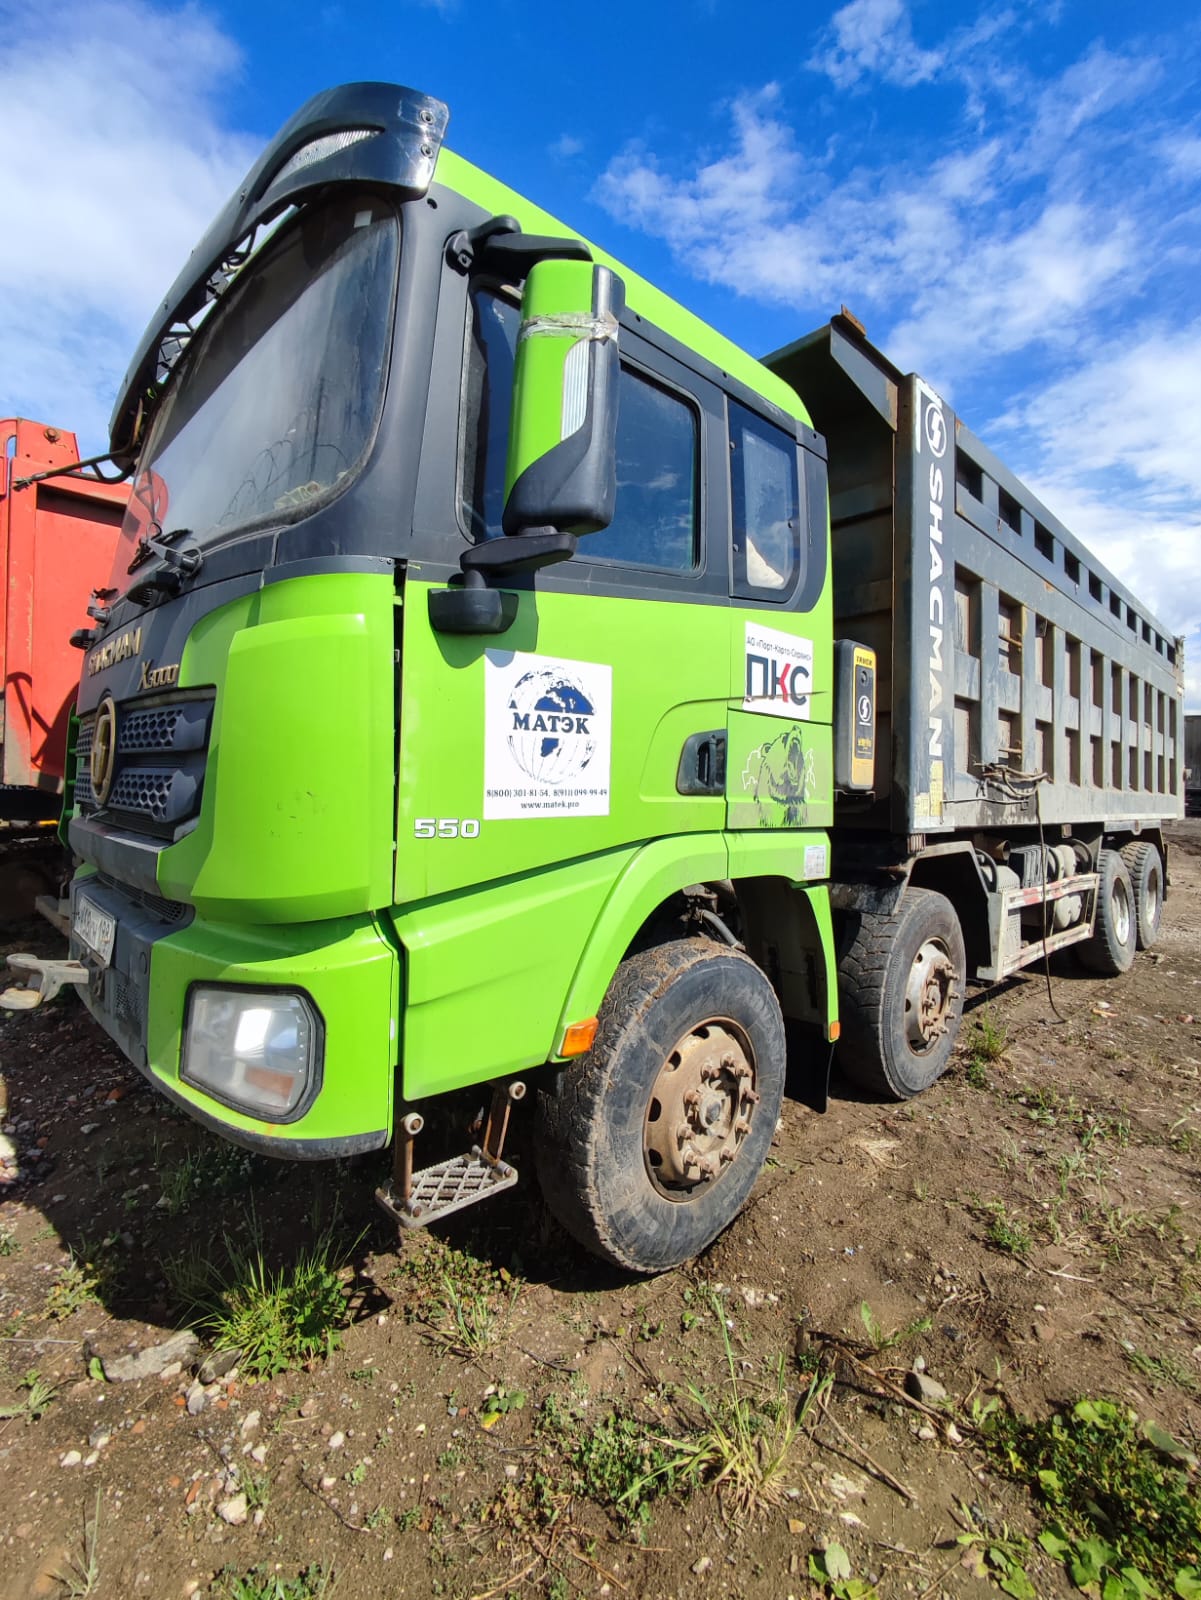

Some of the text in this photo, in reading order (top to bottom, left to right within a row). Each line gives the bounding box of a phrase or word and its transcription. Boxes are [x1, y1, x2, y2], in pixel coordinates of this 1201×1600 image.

[929, 463, 944, 757] SHACMAN
[746, 653, 810, 706] ПКС
[513, 712, 590, 735] МАТЭК
[520, 800, 580, 810] www.matek.pro
[414, 818, 480, 838] 550
